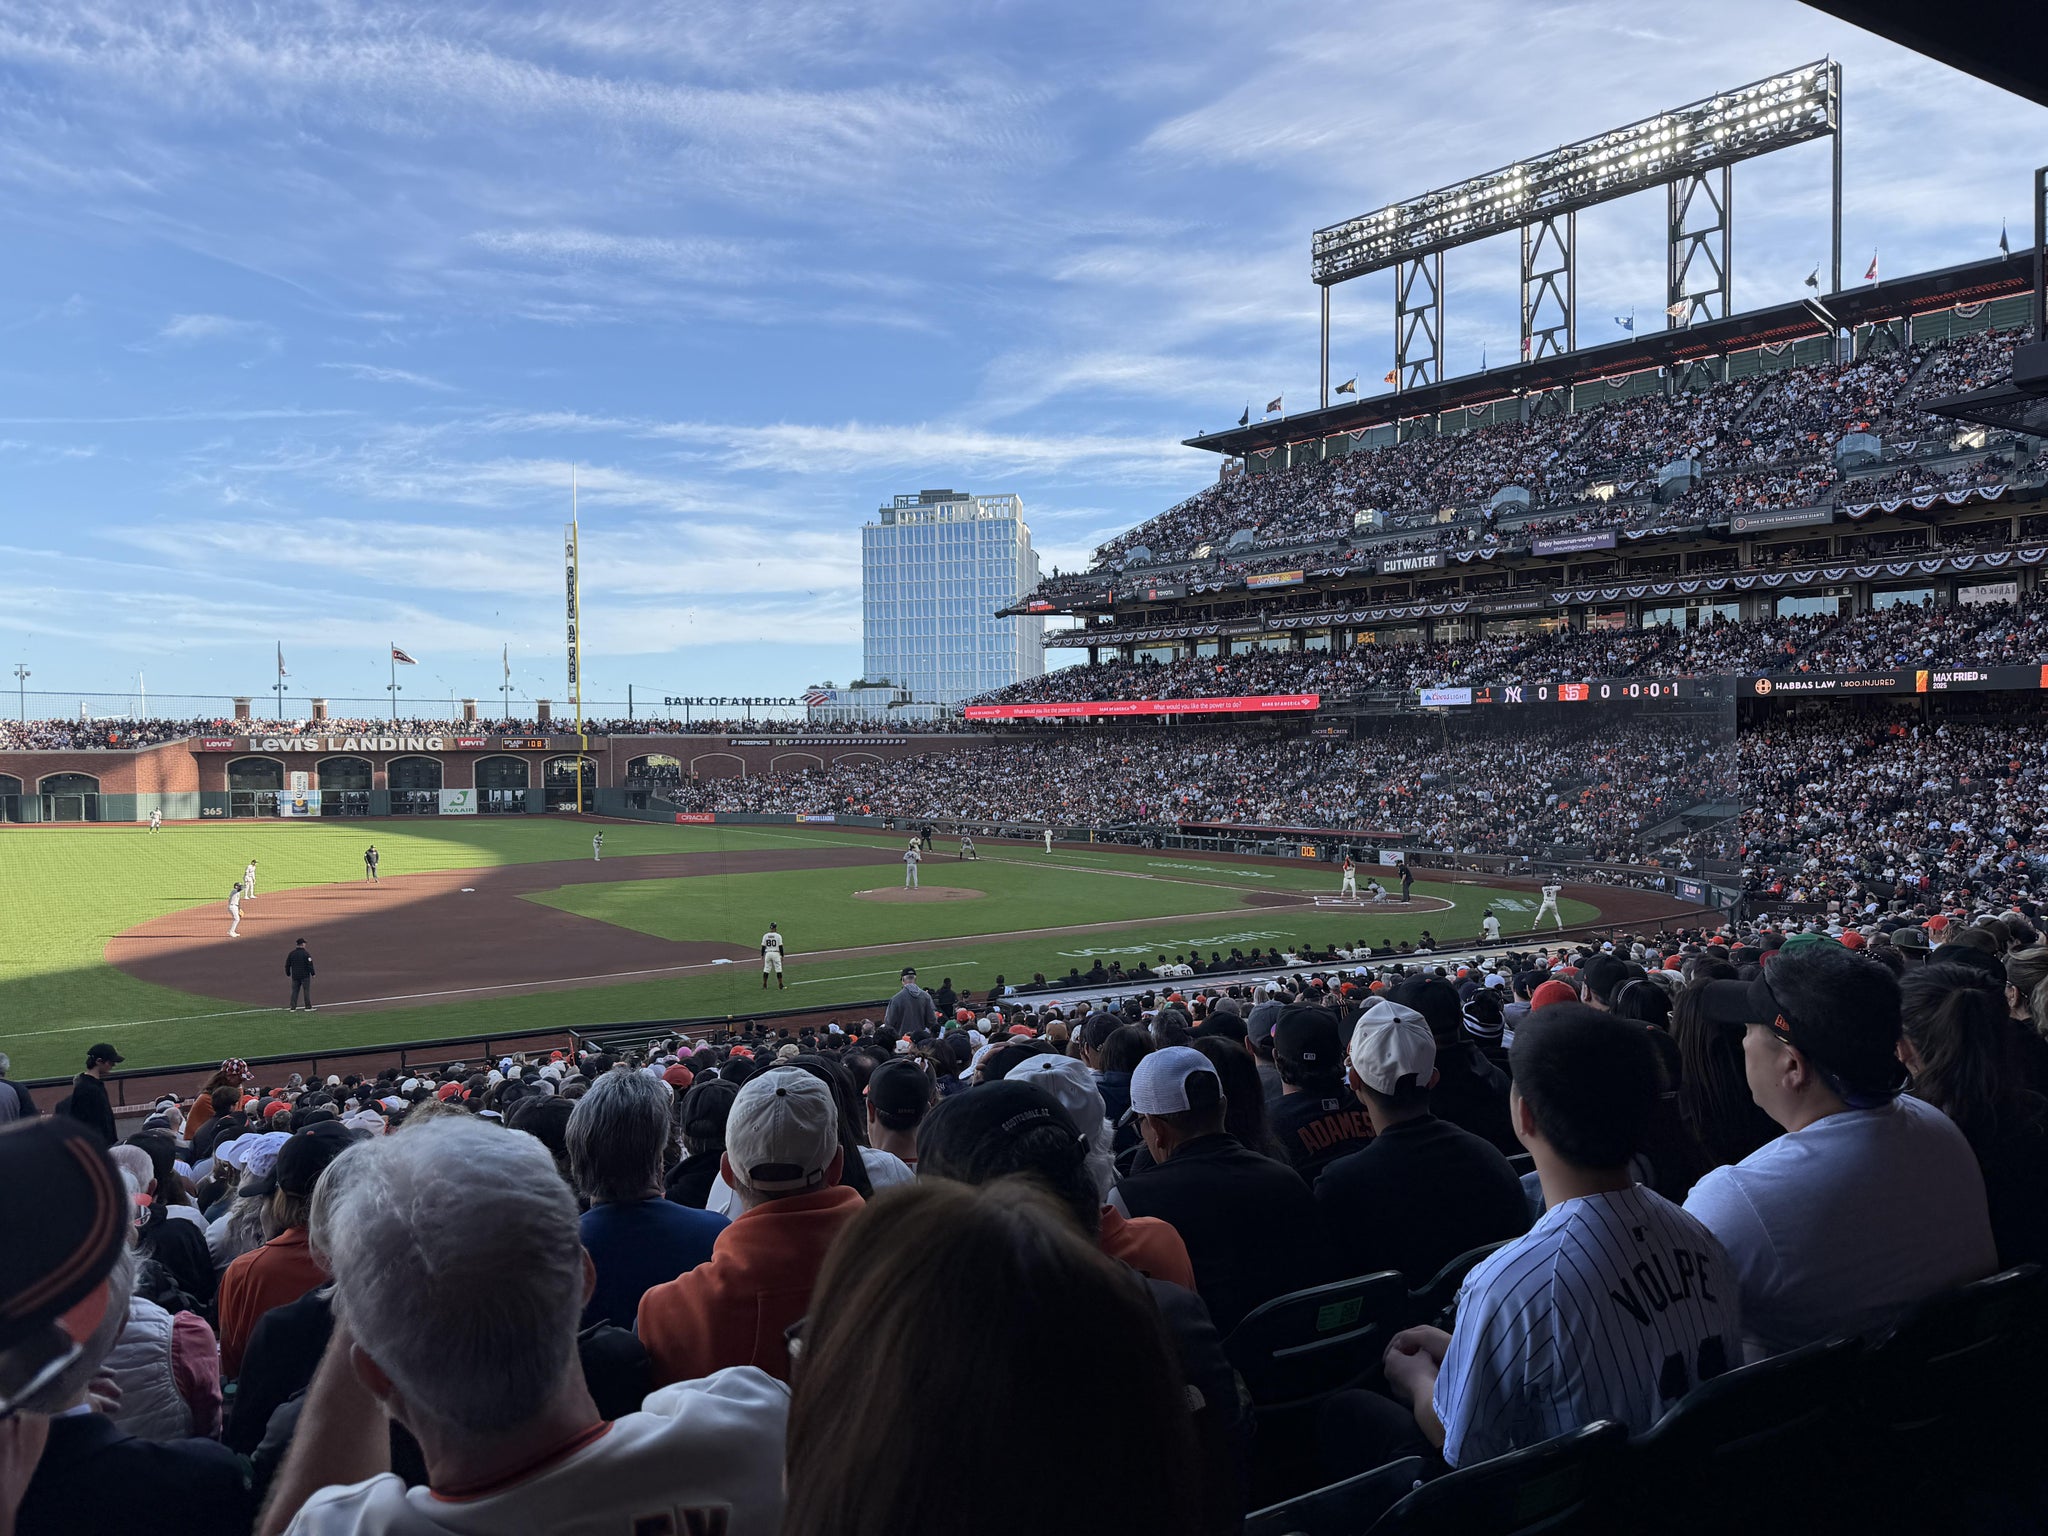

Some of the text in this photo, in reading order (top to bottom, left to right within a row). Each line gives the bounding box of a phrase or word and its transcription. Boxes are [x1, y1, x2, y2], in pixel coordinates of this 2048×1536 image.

[1553, 536, 1597, 546] homerun-worthy
[1933, 672, 1952, 682] MAX
[1953, 672, 1978, 682] FRIED
[1776, 682, 1814, 690] HABBAS
[1815, 680, 1836, 689] LAW
[1485, 687, 1490, 697] 1
[1539, 687, 1547, 700] 0
[1600, 685, 1610, 698] 0
[1630, 684, 1639, 697] 0
[1650, 683, 1659, 697] 0
[1672, 683, 1678, 696] 1
[664, 696, 796, 706] BANK OF AMERICA
[328, 737, 444, 751] LANDING
[1610, 1248, 1716, 1327] VOLPE
